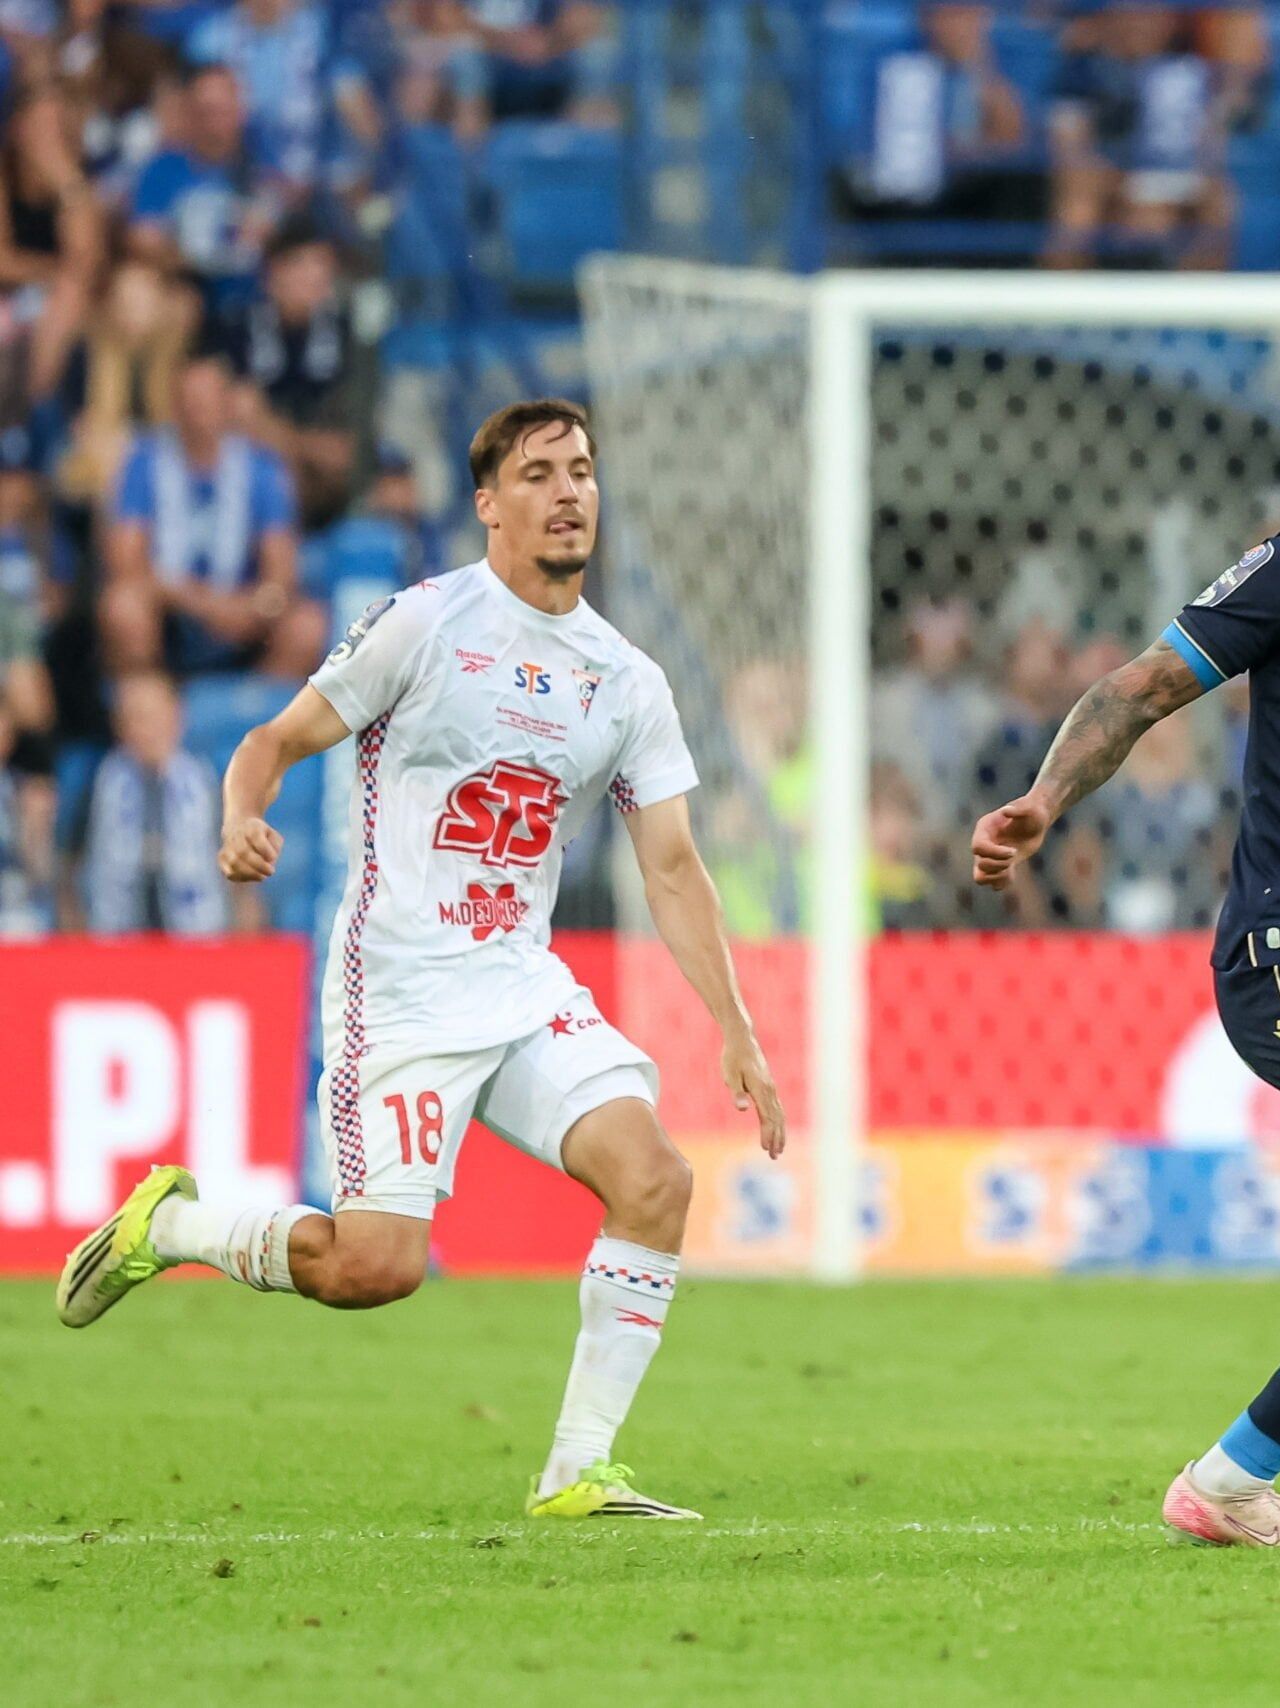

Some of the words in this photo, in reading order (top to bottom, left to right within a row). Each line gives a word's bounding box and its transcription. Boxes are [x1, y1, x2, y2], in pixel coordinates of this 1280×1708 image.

[515, 663, 551, 694] STS
[433, 760, 566, 868] STS
[383, 1091, 443, 1165] 18
